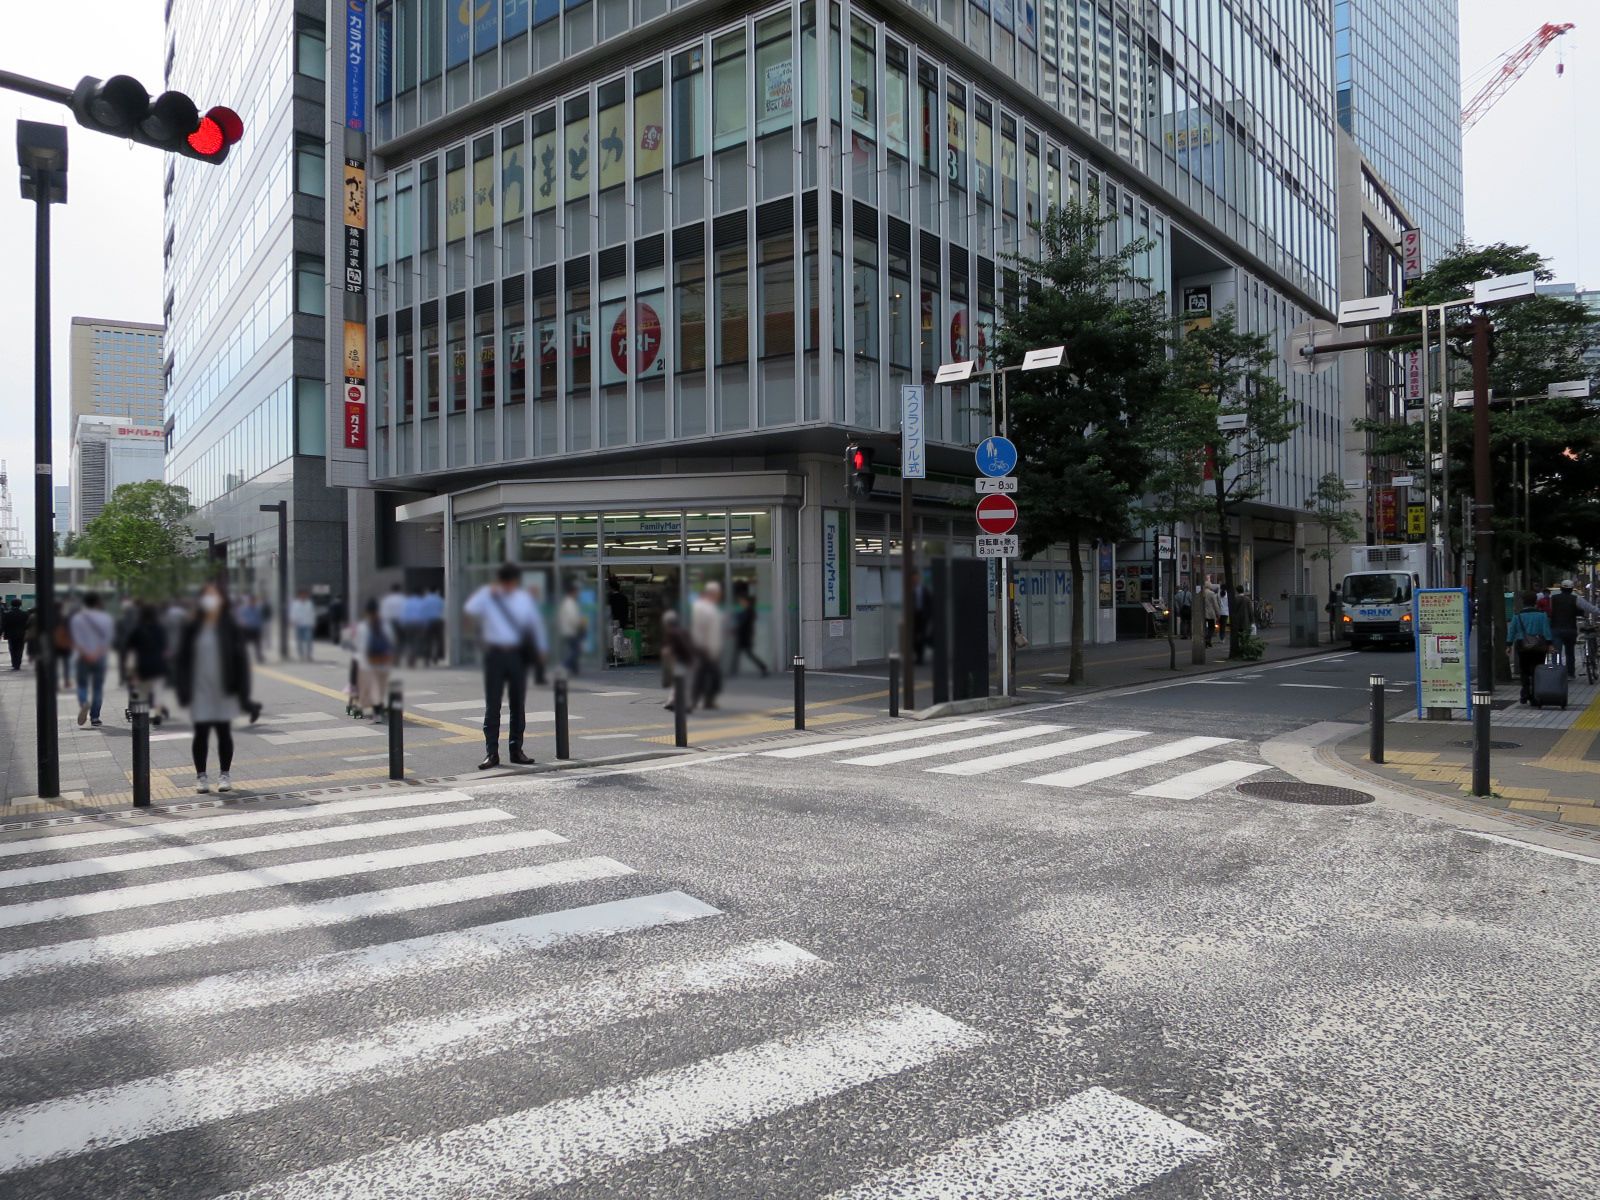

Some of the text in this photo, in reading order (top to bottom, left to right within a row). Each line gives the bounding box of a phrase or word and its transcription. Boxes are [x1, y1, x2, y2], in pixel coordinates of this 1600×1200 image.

[350, 15, 362, 64] カラオケ
[1405, 233, 1417, 271] タンス
[347, 285, 360, 293] 3F
[351, 414, 360, 444] ガスト
[827, 524, 836, 601] FamilyMart
